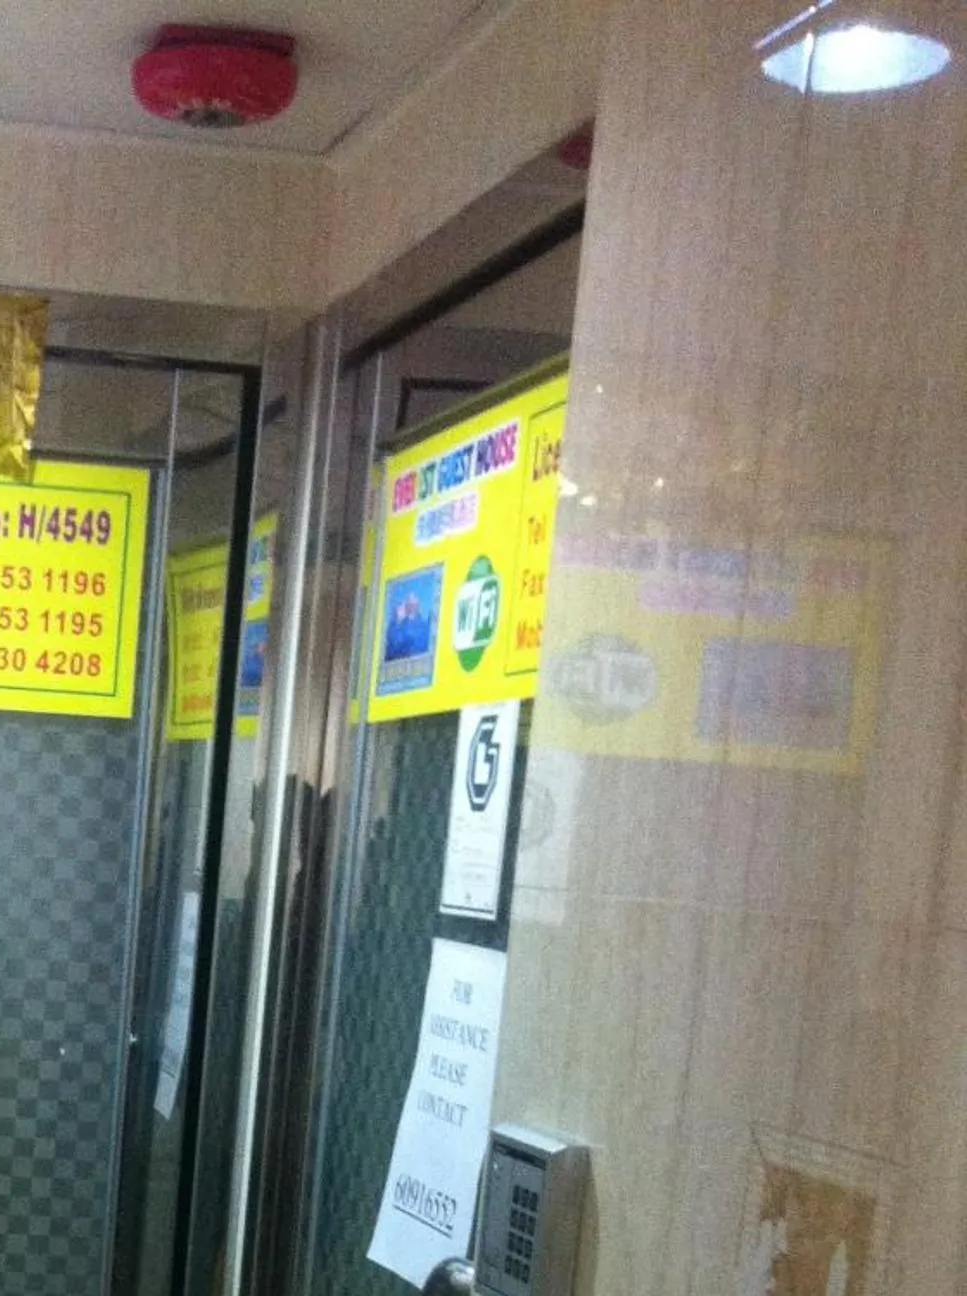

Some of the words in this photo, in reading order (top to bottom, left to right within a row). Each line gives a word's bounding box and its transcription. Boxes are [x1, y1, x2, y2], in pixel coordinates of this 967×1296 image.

[17, 502, 112, 546] H/4549
[42, 567, 107, 598] 1196
[39, 609, 104, 638] 1195
[34, 650, 102, 678] 4208
